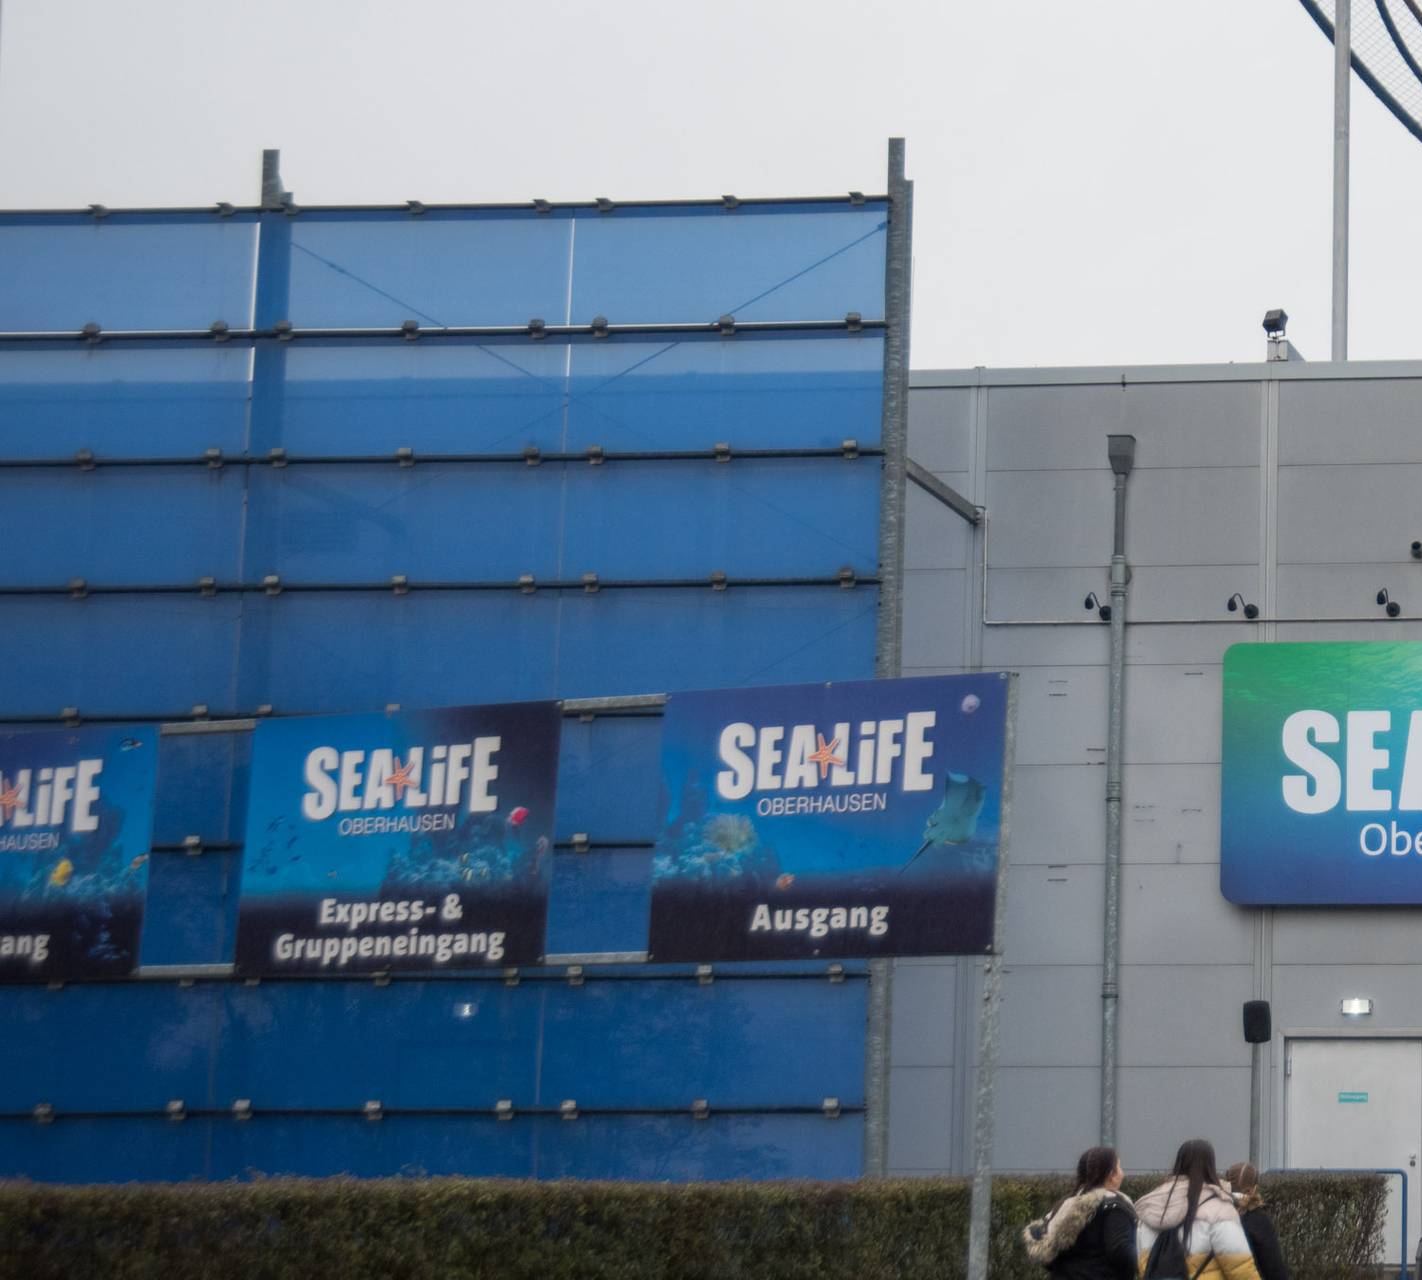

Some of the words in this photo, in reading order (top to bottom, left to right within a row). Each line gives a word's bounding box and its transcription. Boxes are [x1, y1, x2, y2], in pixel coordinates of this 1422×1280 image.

[717, 721, 818, 800] SEA
[303, 746, 395, 821] SEA
[757, 793, 887, 816] OBERHAUSEN
[338, 814, 456, 836] OBERHAUSEN
[320, 898, 436, 930] Express-
[442, 893, 463, 920] &
[750, 904, 889, 937] Ausgang
[274, 928, 506, 965] Gruppeneingang
